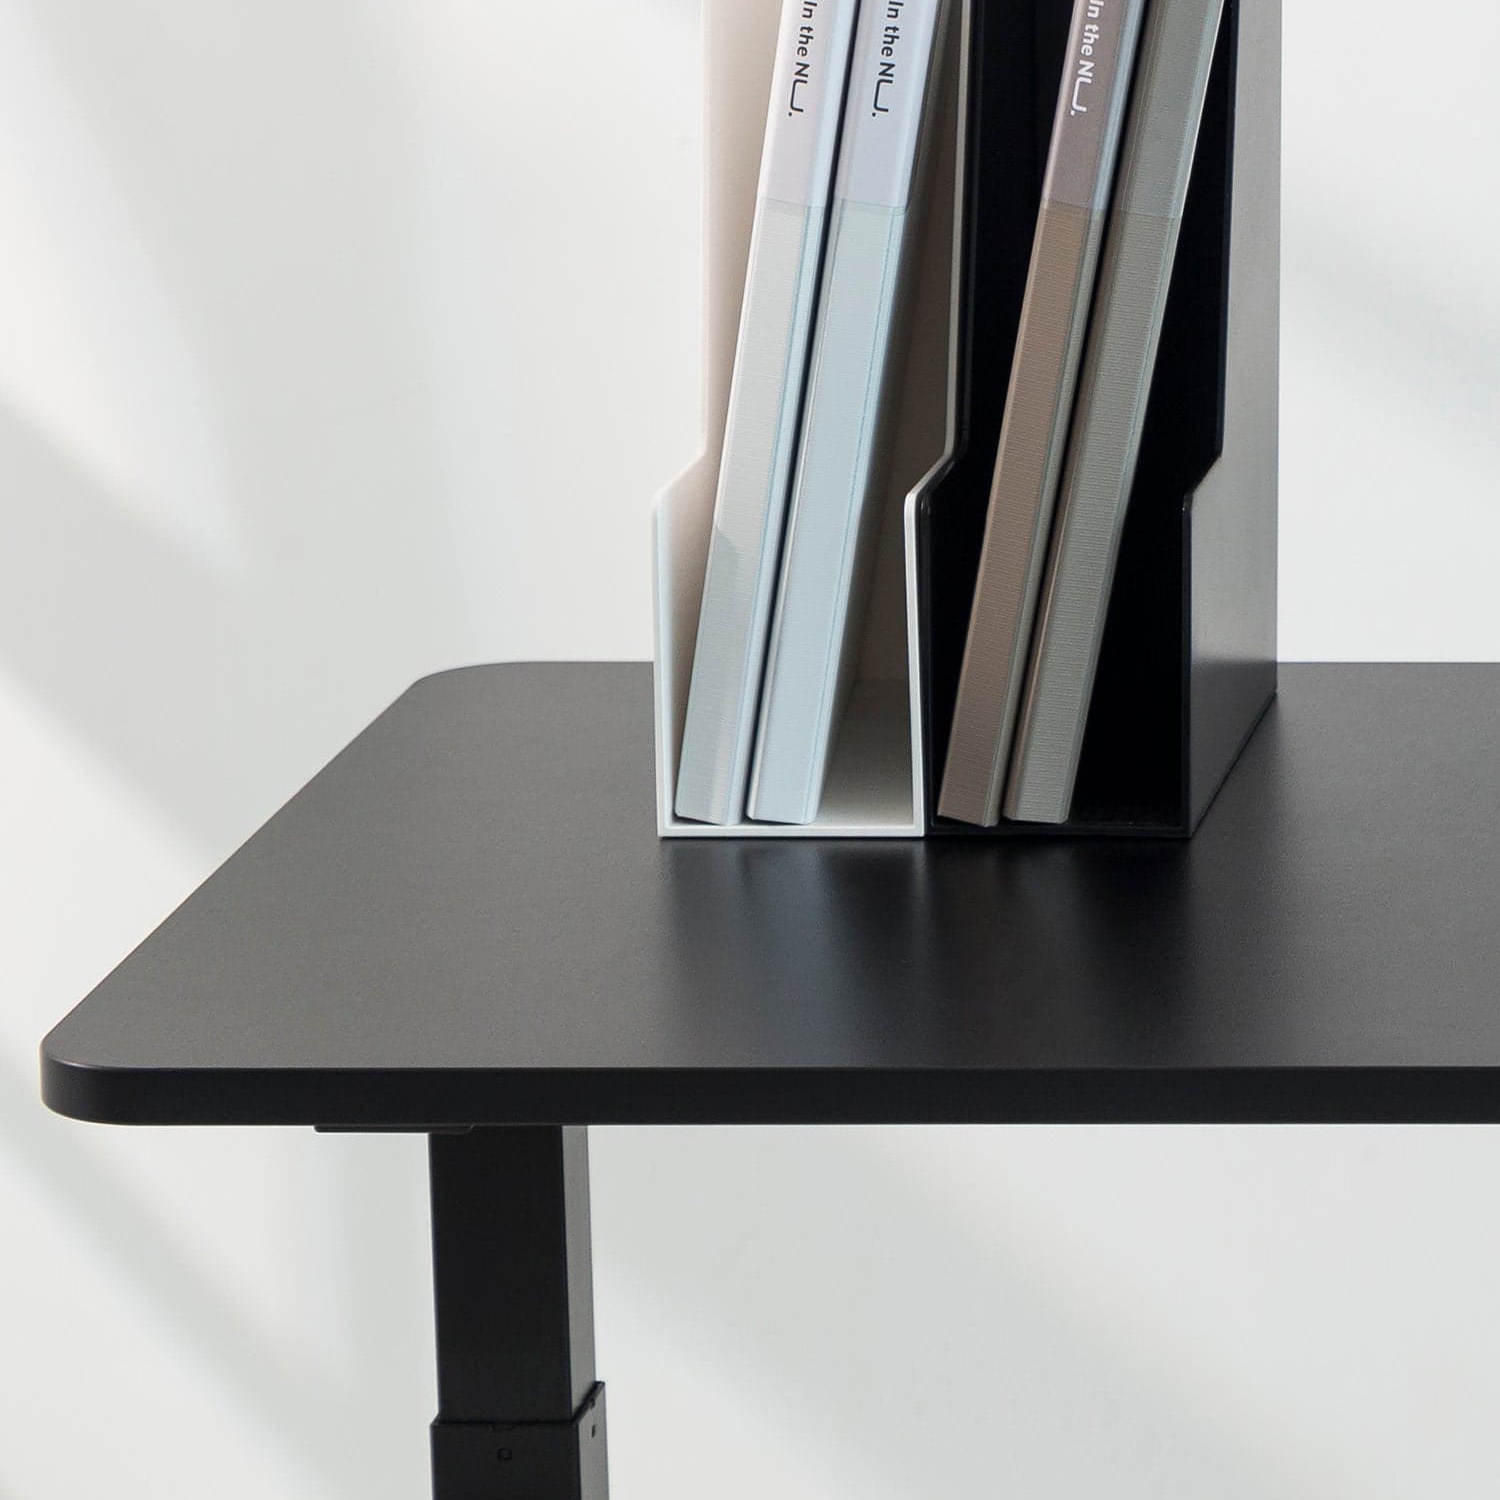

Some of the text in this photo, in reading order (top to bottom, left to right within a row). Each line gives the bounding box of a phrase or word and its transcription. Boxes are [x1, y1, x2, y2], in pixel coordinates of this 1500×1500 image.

[801, 0, 818, 20] In
[885, 0, 904, 20] In
[795, 23, 815, 58] the
[881, 23, 902, 58] the
[1080, 23, 1099, 56] the
